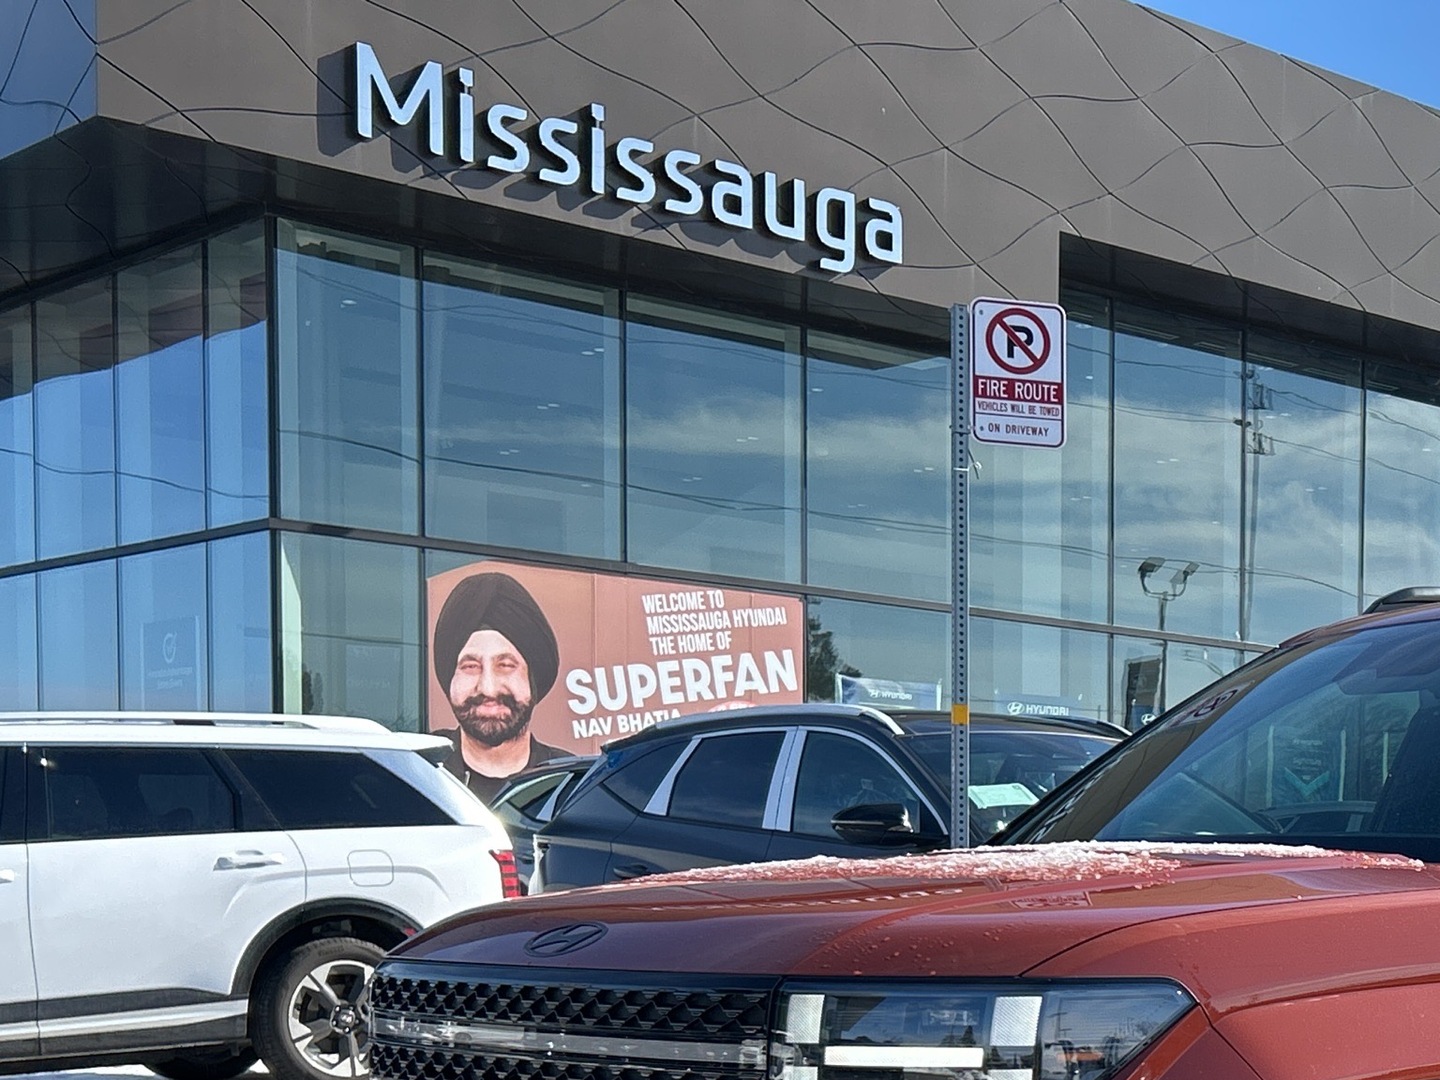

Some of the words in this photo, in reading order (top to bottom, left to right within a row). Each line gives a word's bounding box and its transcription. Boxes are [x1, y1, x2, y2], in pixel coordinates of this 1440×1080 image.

[355, 41, 903, 273] Mississauga
[978, 379, 1008, 398] FIRE
[1015, 382, 1059, 402] ROUTE
[977, 401, 1008, 413] VEHICLES
[1010, 404, 1025, 414] WILL
[1028, 405, 1037, 416] BE
[1039, 406, 1060, 417] TOWED
[988, 423, 1000, 433] ON
[1005, 424, 1049, 437] DRIVEWAY
[642, 591, 707, 614] WELCOME
[707, 590, 725, 609] TO
[646, 610, 732, 635] MISSISSAUGA
[732, 607, 788, 628] HYUNDAI
[649, 636, 676, 656] THE
[677, 633, 715, 653] HOME
[716, 631, 732, 650] OF
[565, 649, 798, 715] SUPERFAN
[1026, 704, 1069, 716] HYUNDAI
[572, 716, 613, 739] NAV
